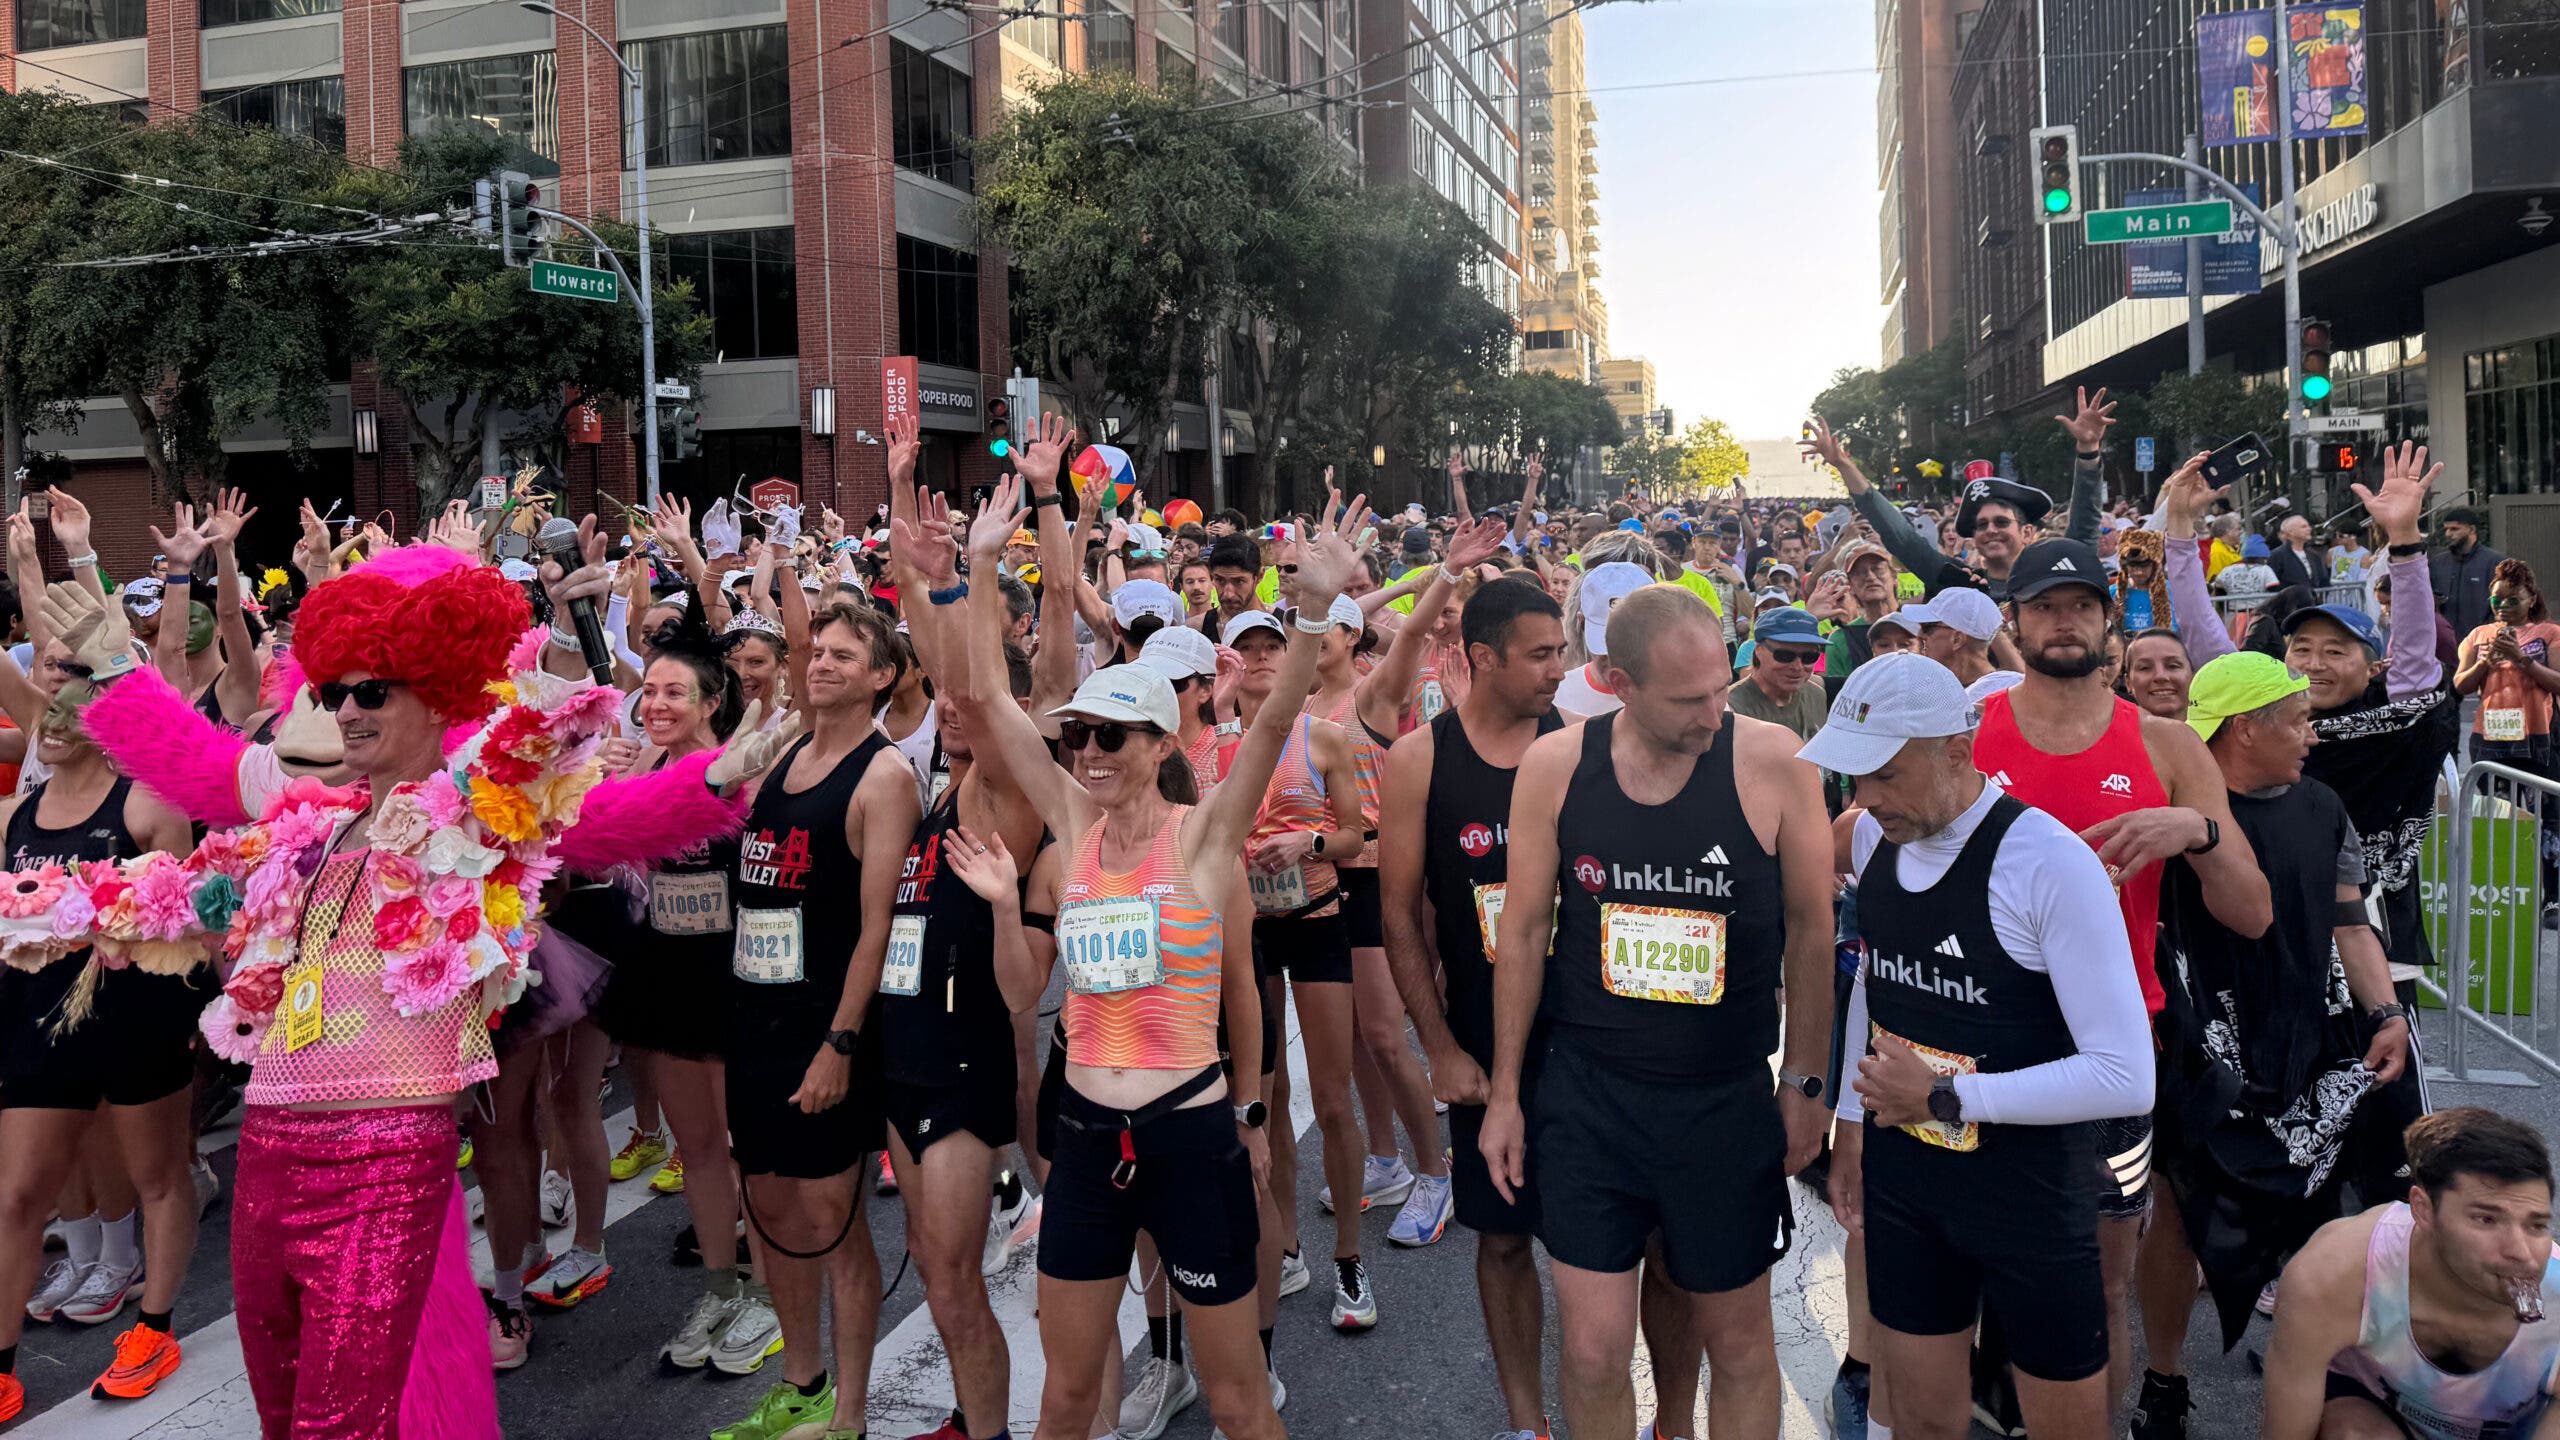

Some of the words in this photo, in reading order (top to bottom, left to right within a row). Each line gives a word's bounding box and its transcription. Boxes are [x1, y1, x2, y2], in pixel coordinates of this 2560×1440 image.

[2126, 213, 2190, 233] Main
[2305, 183, 2377, 254] SCHWAB
[2218, 230, 2256, 244] BAY
[546, 269, 604, 293] Howard
[886, 368, 897, 421] PROPER
[897, 376, 907, 412] FOOD
[918, 390, 948, 406] ROPER
[949, 393, 973, 408] FOOD
[2328, 418, 2361, 428] MAIN
[1110, 691, 1137, 704] HOKA
[2100, 773, 2133, 793] AR
[741, 831, 776, 861] WEST
[1143, 884, 1175, 895] HOKA
[1613, 863, 1735, 898] InkLink
[658, 892, 723, 915] A10667
[1100, 911, 1149, 925] CENTIPEDE
[1685, 925, 1711, 939] 12K
[1066, 928, 1148, 965] A10149
[1614, 937, 1710, 974] A12290
[1873, 948, 1990, 1006] InkLink
[293, 1029, 315, 1047] STAFF
[1173, 1263, 1217, 1288] HOKA
